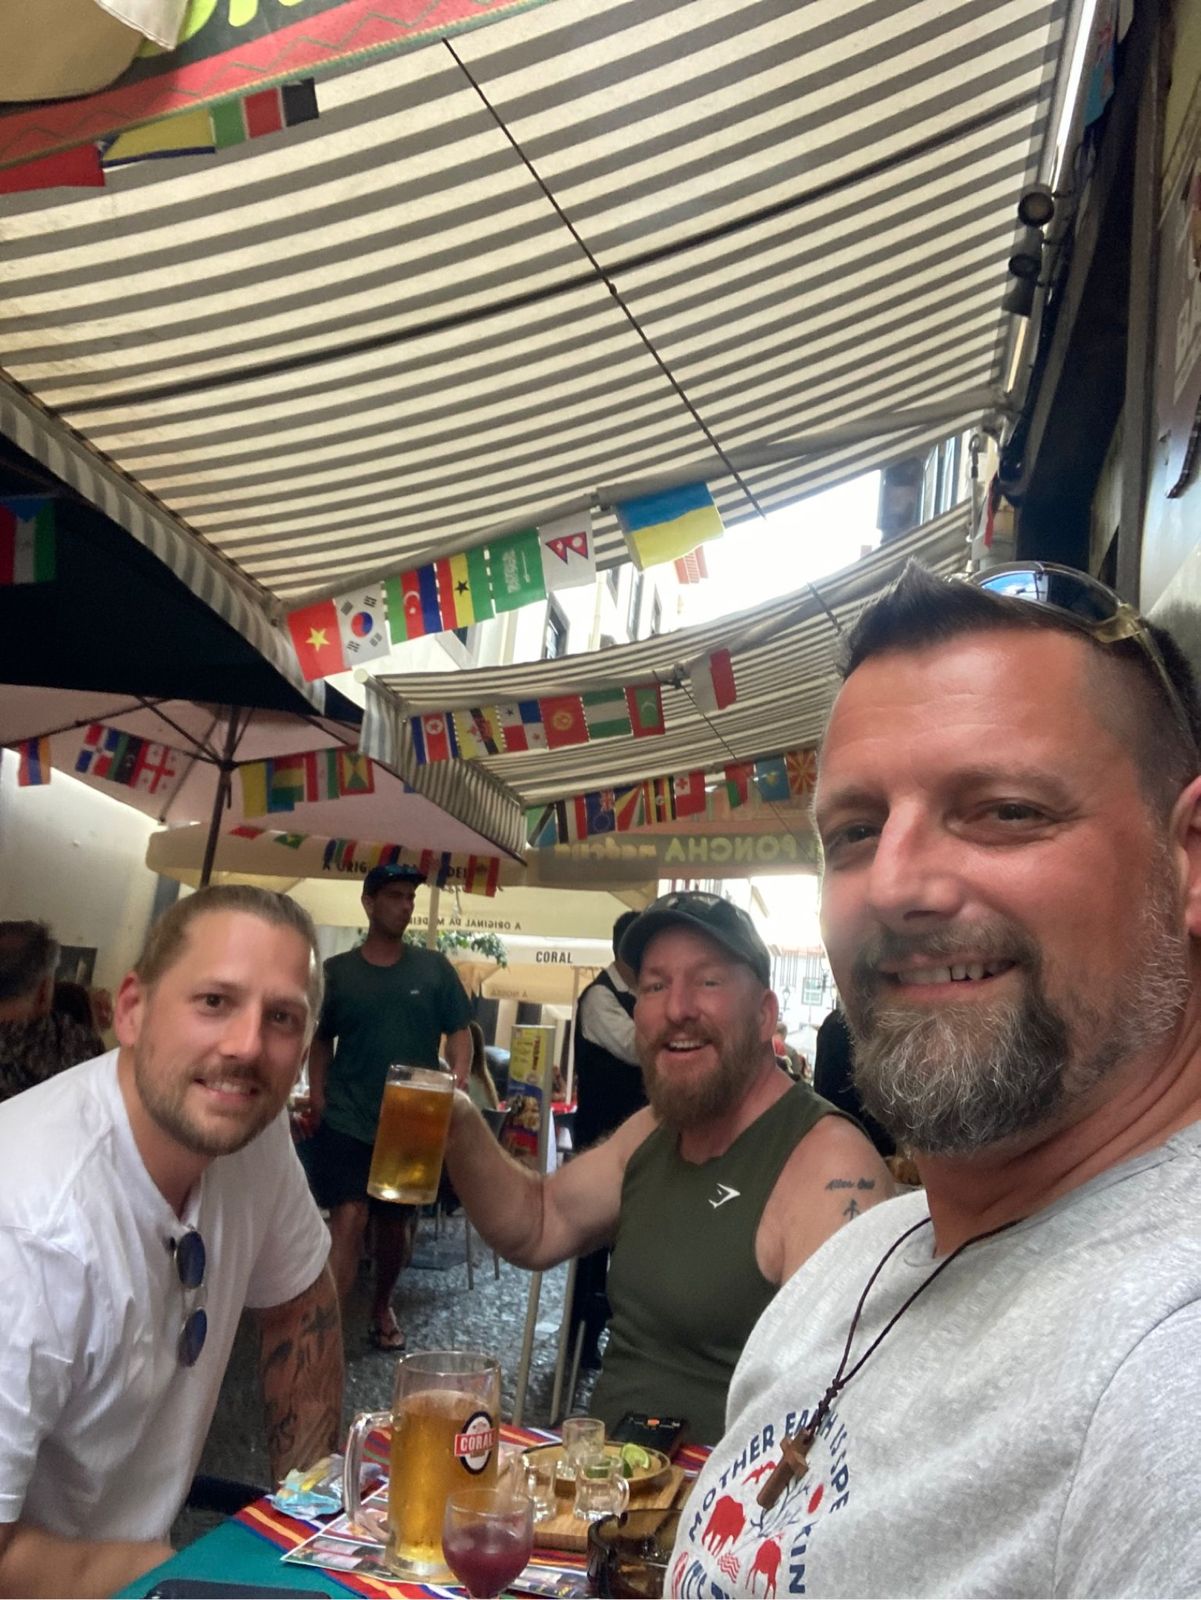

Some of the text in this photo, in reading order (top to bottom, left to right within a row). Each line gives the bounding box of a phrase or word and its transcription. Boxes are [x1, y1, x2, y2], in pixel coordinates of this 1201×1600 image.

[535, 951, 574, 964] CORAL
[460, 1432, 493, 1451] CORAL
[689, 1423, 775, 1542] MOTHER
[784, 1409, 839, 1440] EAH
